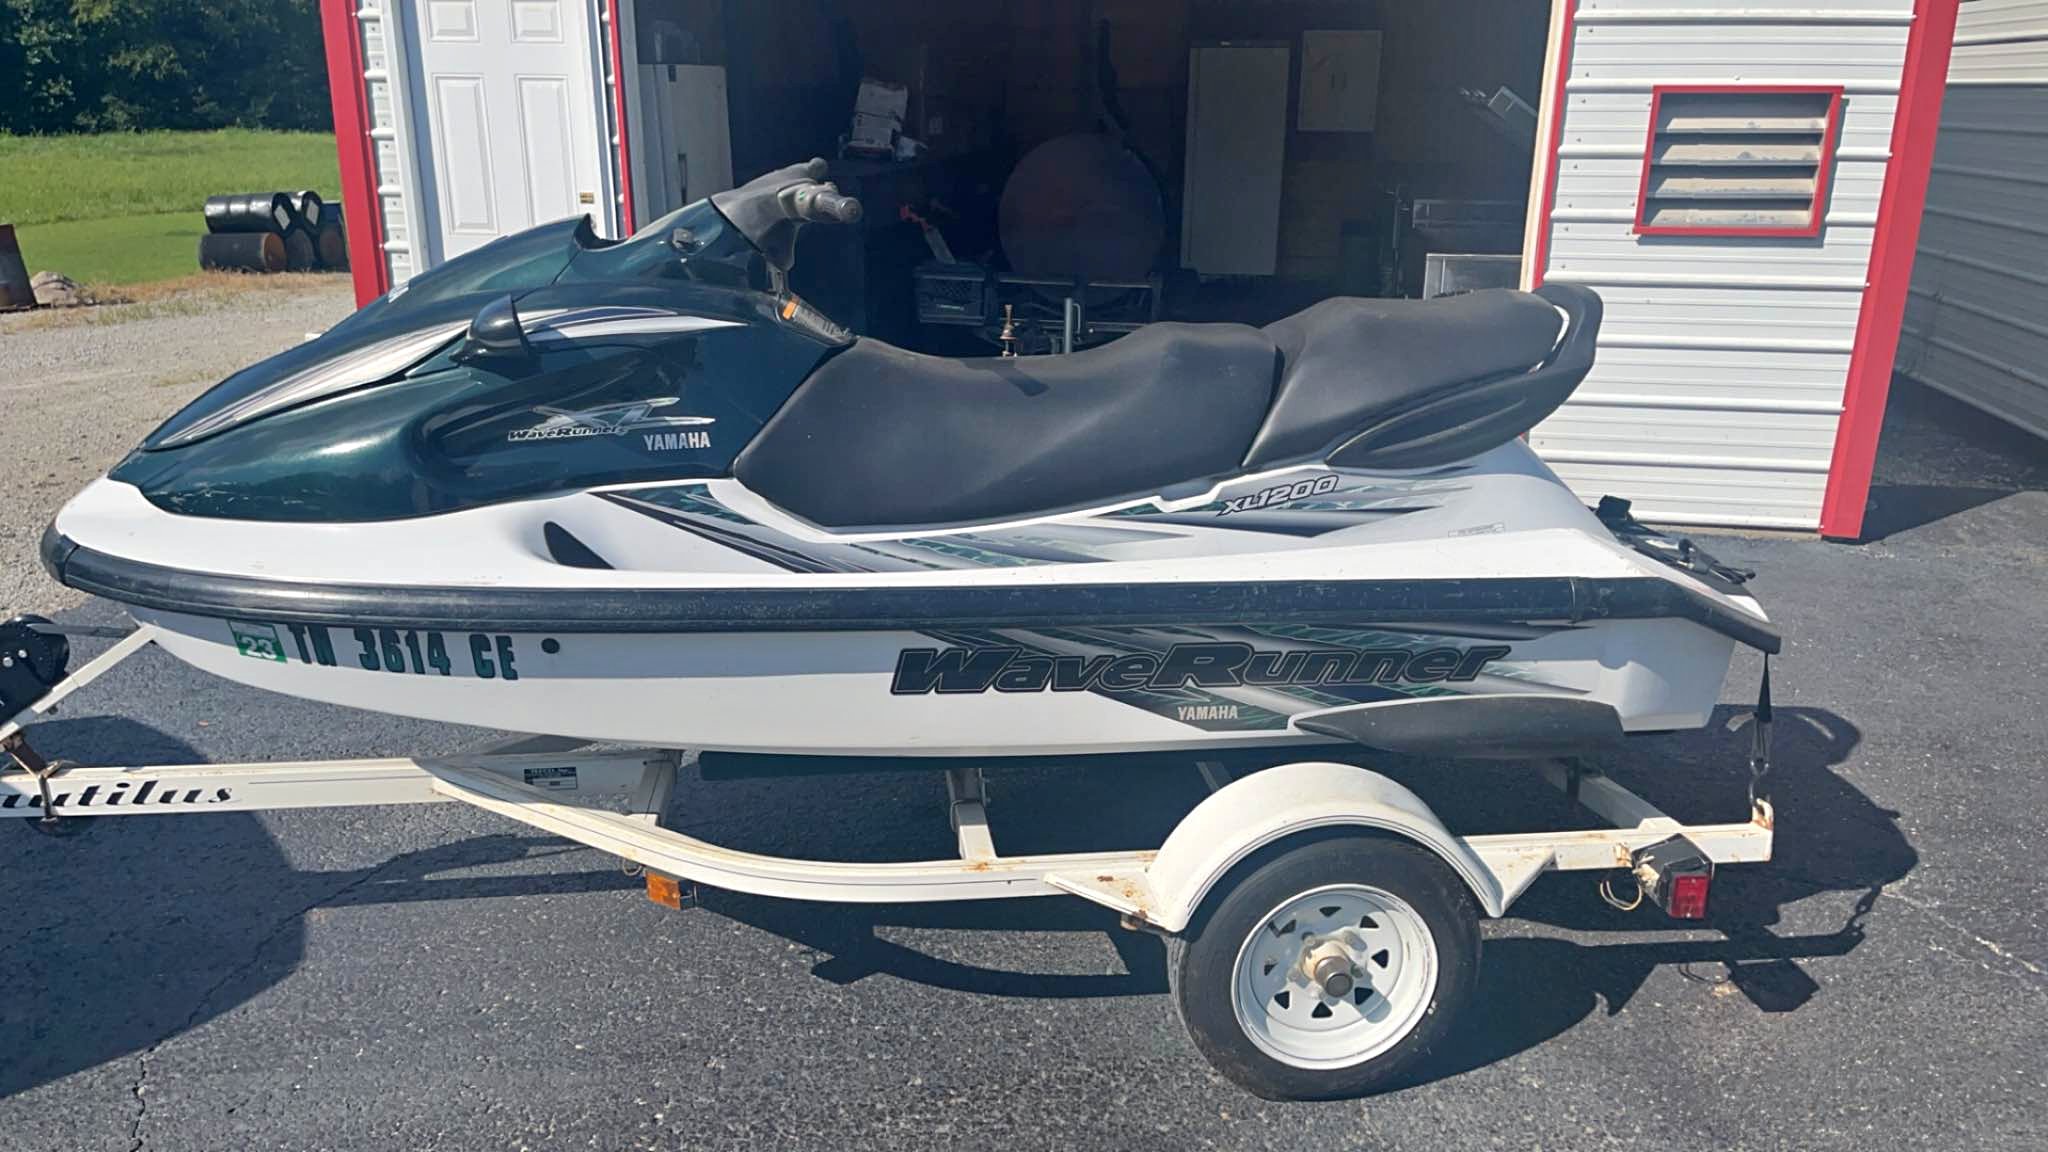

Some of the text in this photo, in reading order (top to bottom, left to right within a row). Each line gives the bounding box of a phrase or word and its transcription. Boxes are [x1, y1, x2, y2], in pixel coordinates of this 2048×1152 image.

[643, 431, 711, 451] YAMAHA
[1216, 475, 1339, 517] XL1200
[241, 636, 277, 660] 23
[286, 624, 519, 680] TN 3614 CE
[891, 642, 1512, 695] WaveRunner
[1177, 705, 1239, 721] YAMAHA
